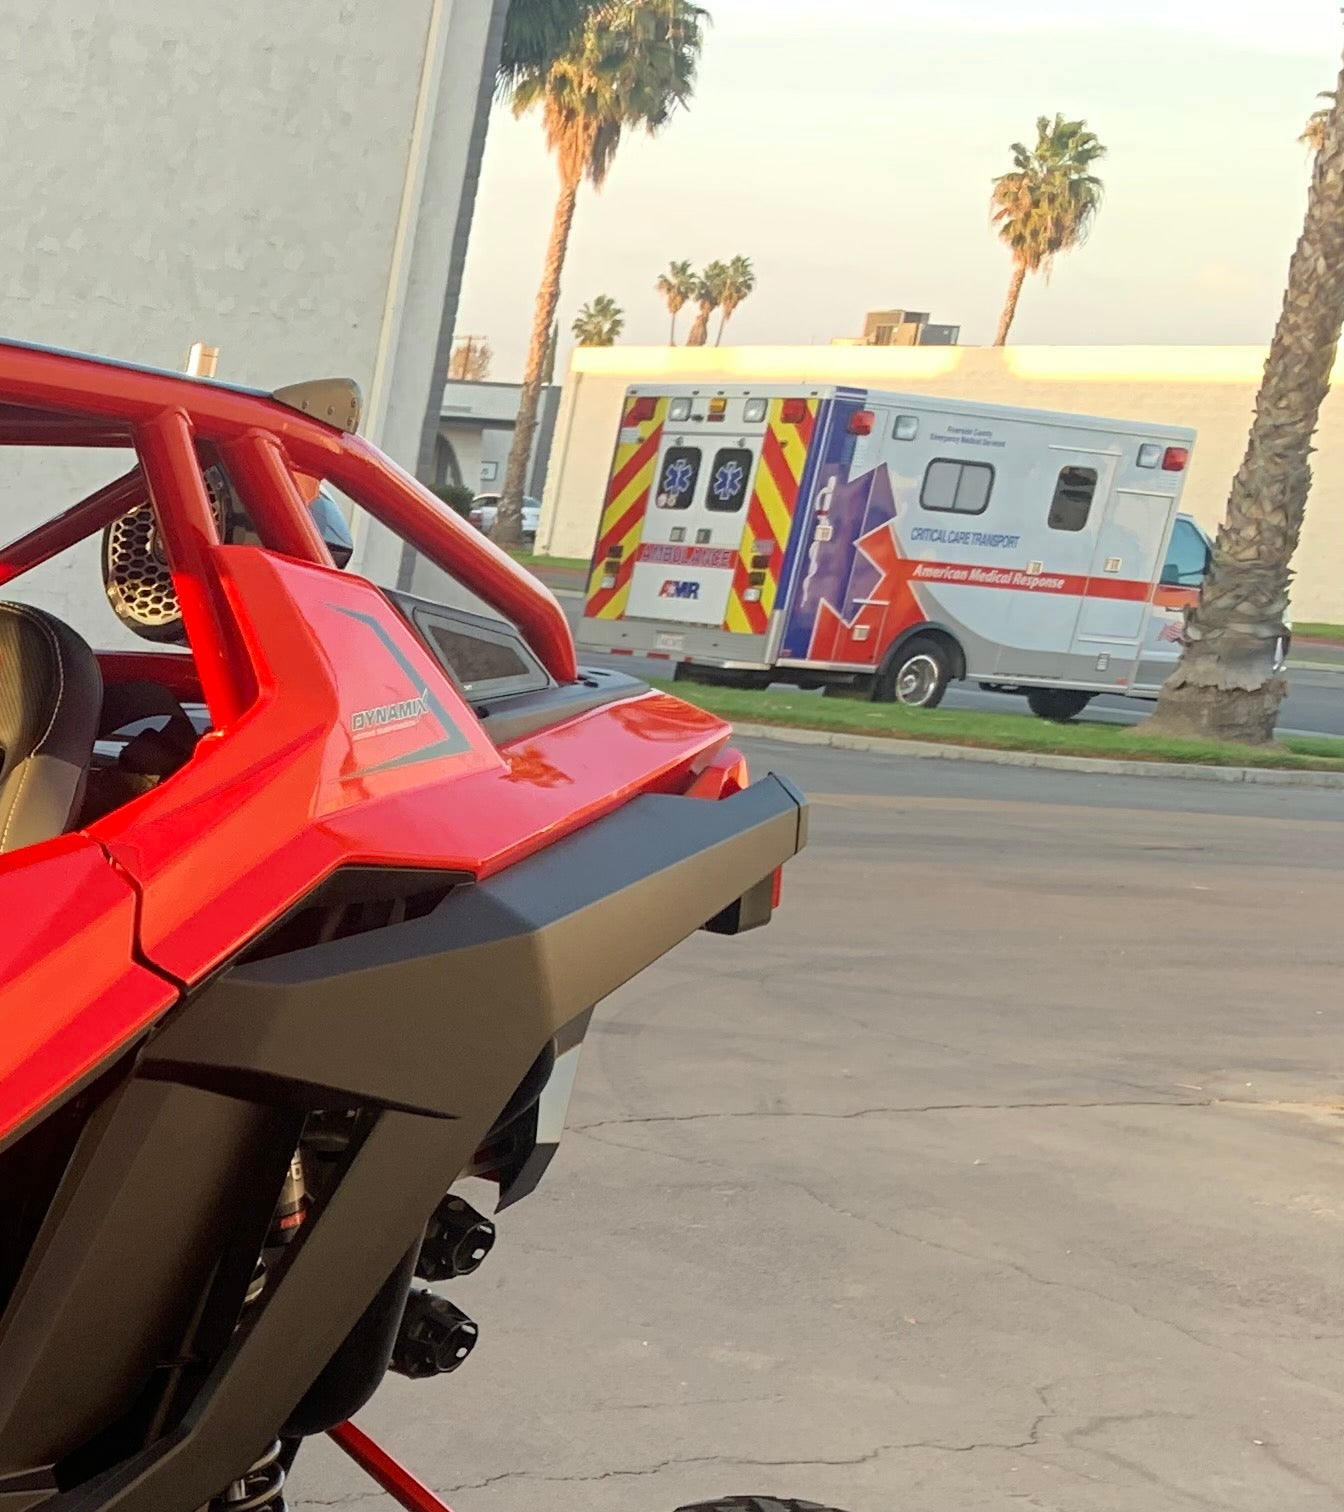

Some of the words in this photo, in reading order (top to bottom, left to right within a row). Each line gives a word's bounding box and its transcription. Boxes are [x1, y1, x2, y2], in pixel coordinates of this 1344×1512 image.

[911, 527, 946, 543] CRITICAL
[947, 531, 970, 545] CARE
[970, 532, 1020, 548] TRANSPORT
[642, 544, 730, 569] AMBULANCE
[913, 564, 967, 581] American
[968, 568, 1012, 584] Medical
[1013, 572, 1065, 589] Response
[658, 580, 700, 600] AMR
[351, 688, 429, 731] DYNAMIX
